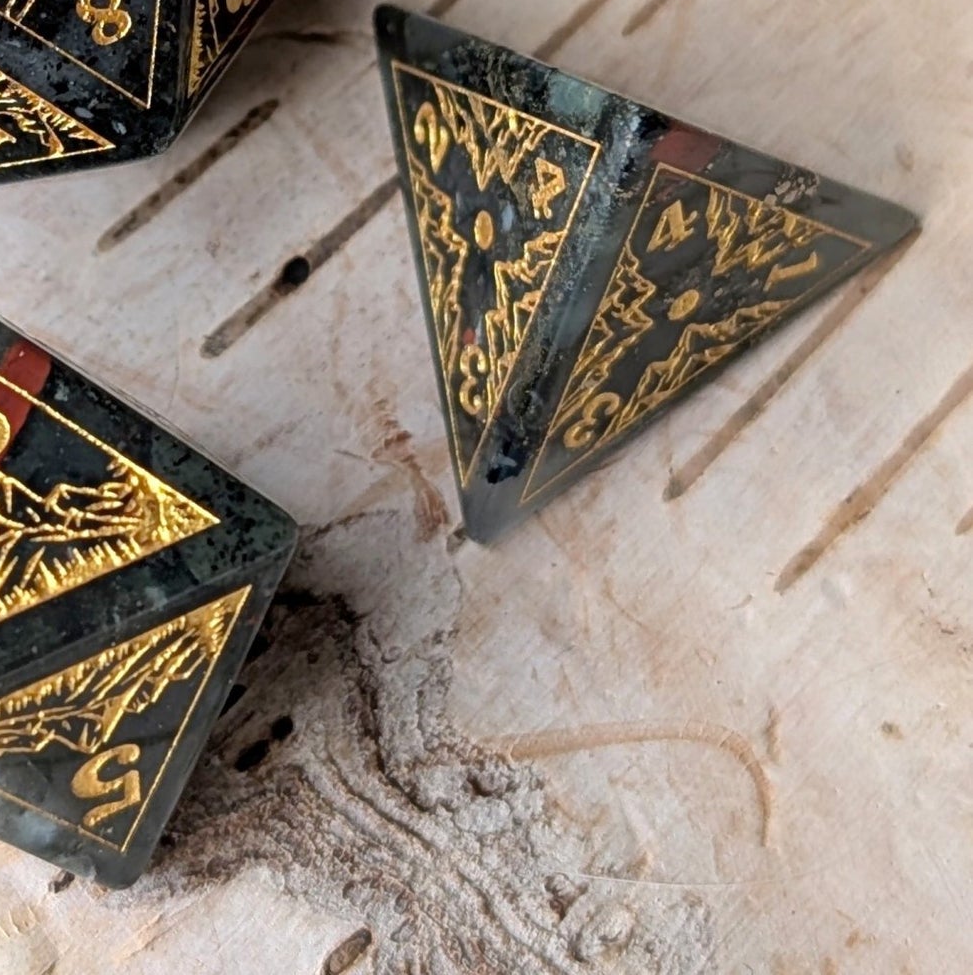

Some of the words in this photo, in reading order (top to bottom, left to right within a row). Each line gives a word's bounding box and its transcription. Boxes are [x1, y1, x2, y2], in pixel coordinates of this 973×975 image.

[413, 101, 450, 173] 2
[531, 156, 566, 220] 4
[645, 198, 698, 253] 4
[762, 251, 819, 293] 1
[459, 343, 486, 416] 3
[562, 391, 621, 449] 3
[70, 742, 142, 828] 5
